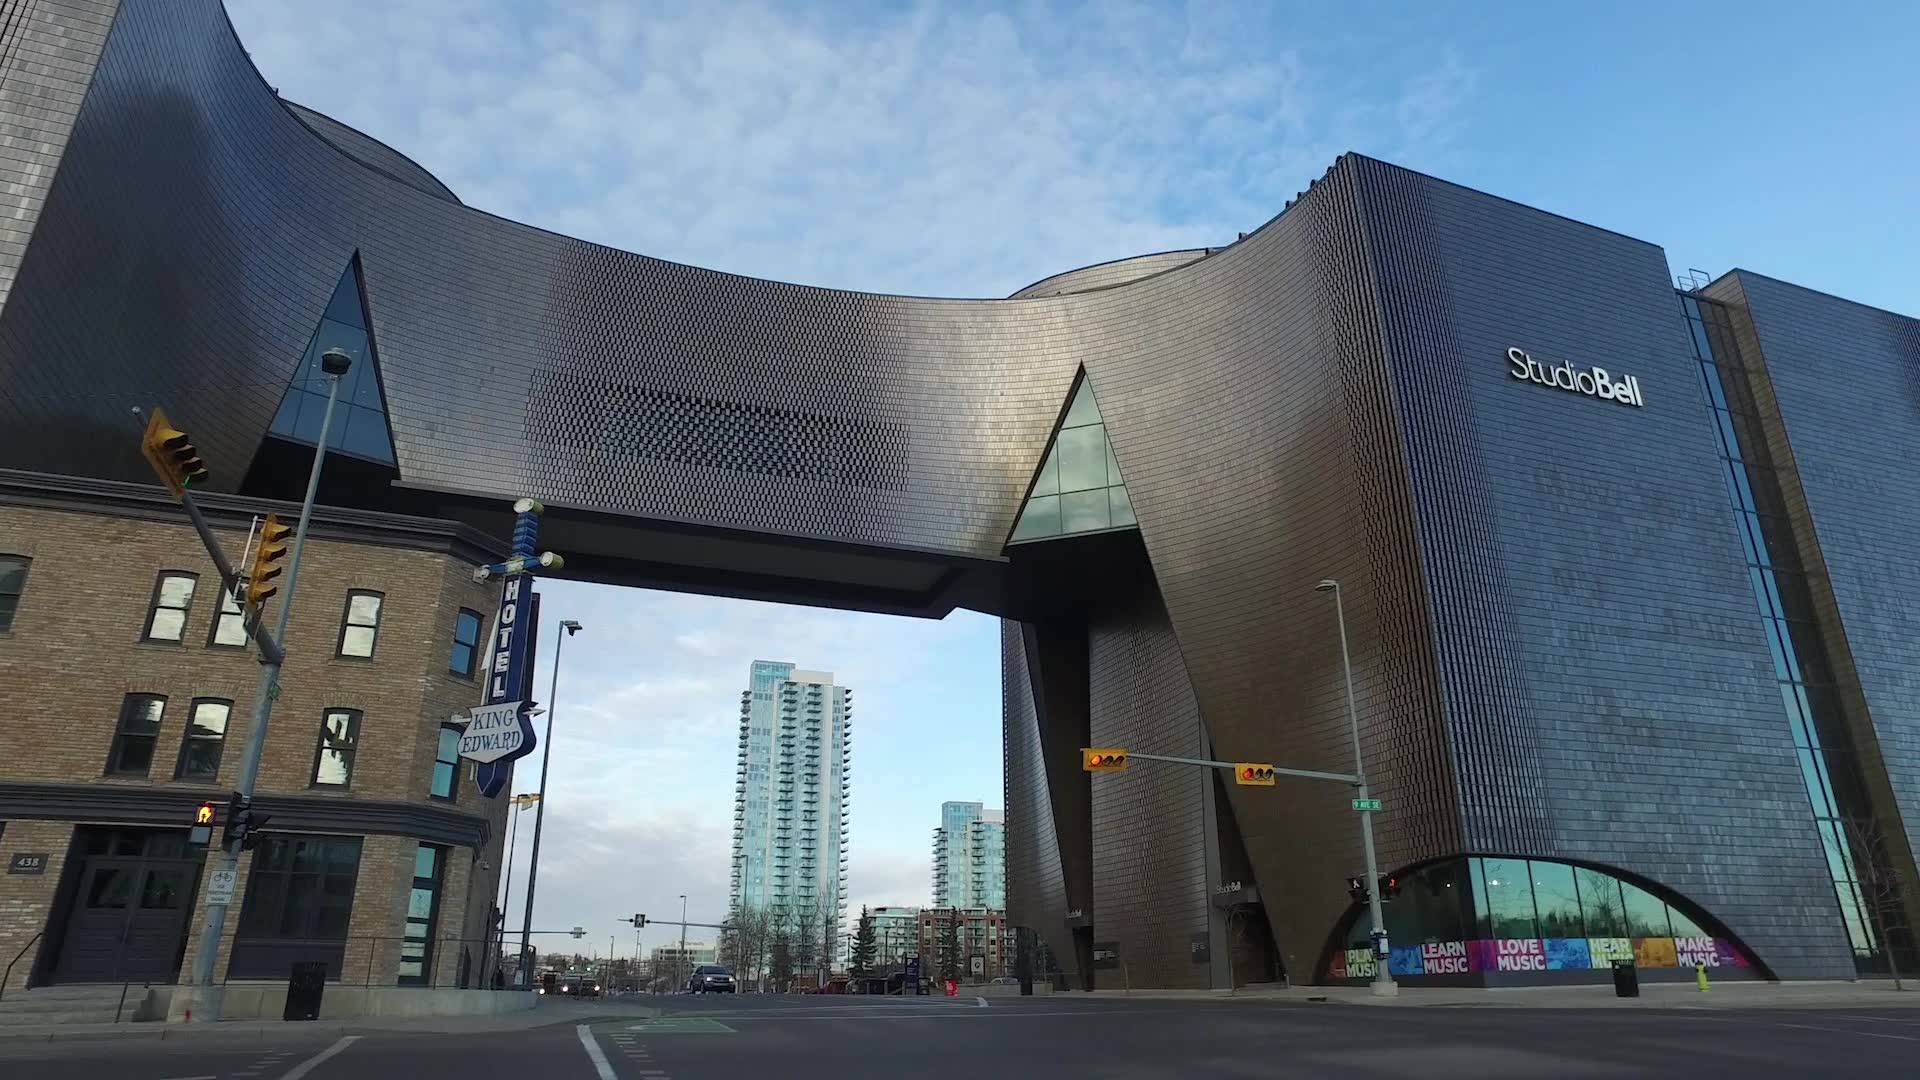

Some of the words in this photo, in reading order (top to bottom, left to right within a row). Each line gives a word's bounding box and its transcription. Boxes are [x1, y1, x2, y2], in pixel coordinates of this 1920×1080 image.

[1507, 347, 1644, 407] StudioBell
[492, 580, 520, 698] HOTEL
[472, 708, 514, 731] KING
[460, 730, 522, 754] EDWARD
[17, 857, 40, 867] 438
[1421, 941, 1466, 958] LEARN
[1498, 939, 1540, 954] LOVE
[1589, 937, 1631, 953] HEAR
[1674, 937, 1715, 952] MAKE
[1422, 957, 1468, 975] MUSIC
[1497, 955, 1546, 971] MUSIC
[1677, 952, 1720, 968] MUSIC
[1346, 961, 1378, 978] MUSI
